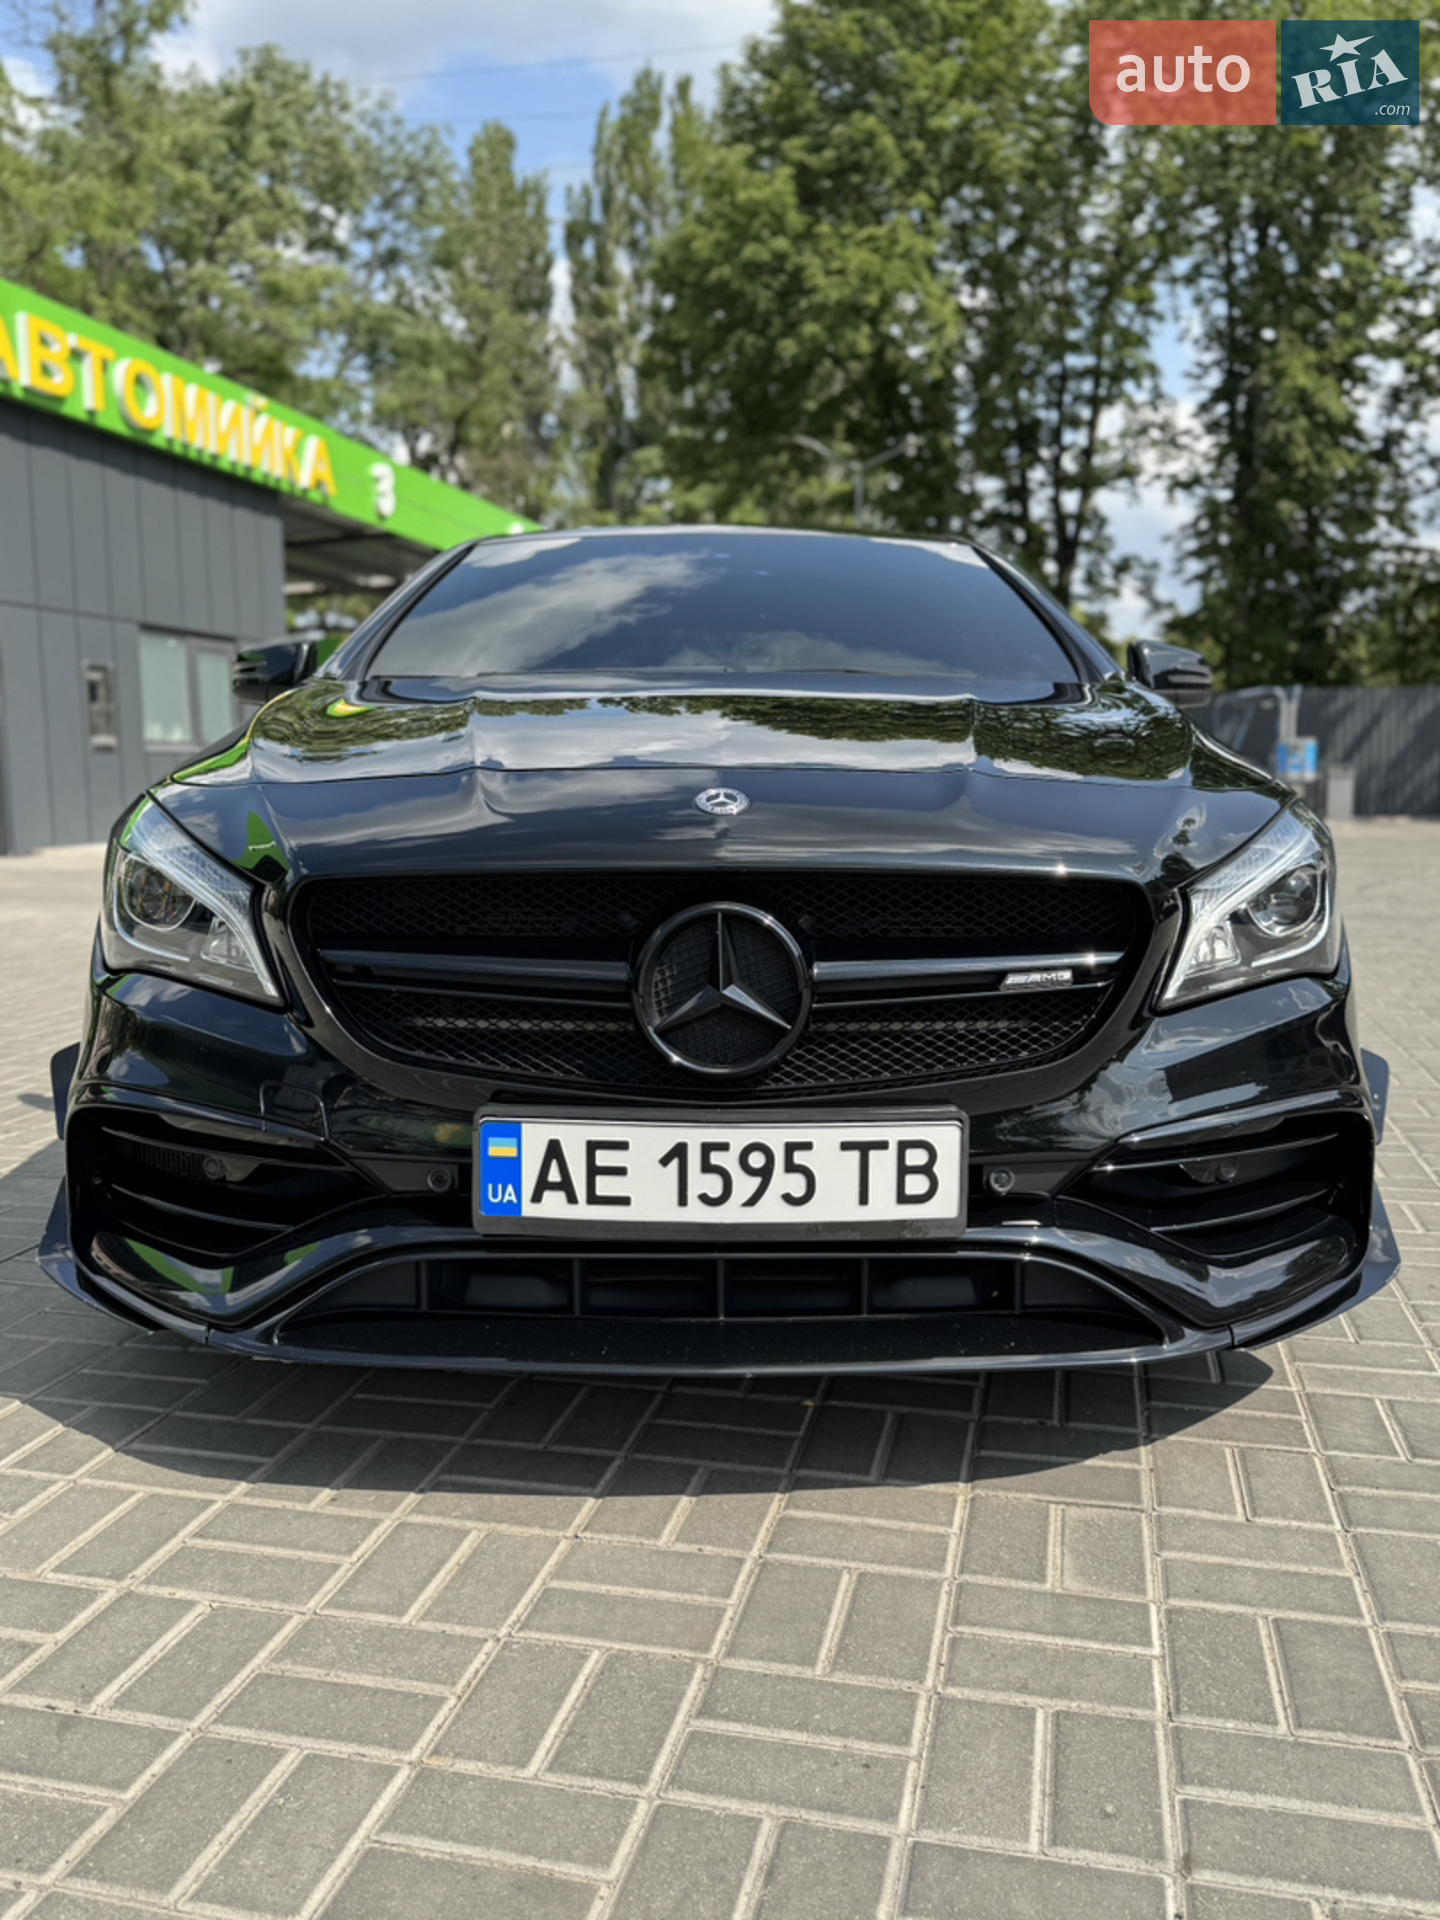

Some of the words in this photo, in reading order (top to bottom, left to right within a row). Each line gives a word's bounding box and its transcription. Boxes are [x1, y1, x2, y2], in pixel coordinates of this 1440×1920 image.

[488, 1183, 518, 1205] UA
[530, 1139, 632, 1206] AE
[658, 1141, 816, 1208] 1595
[840, 1140, 939, 1206] TB
